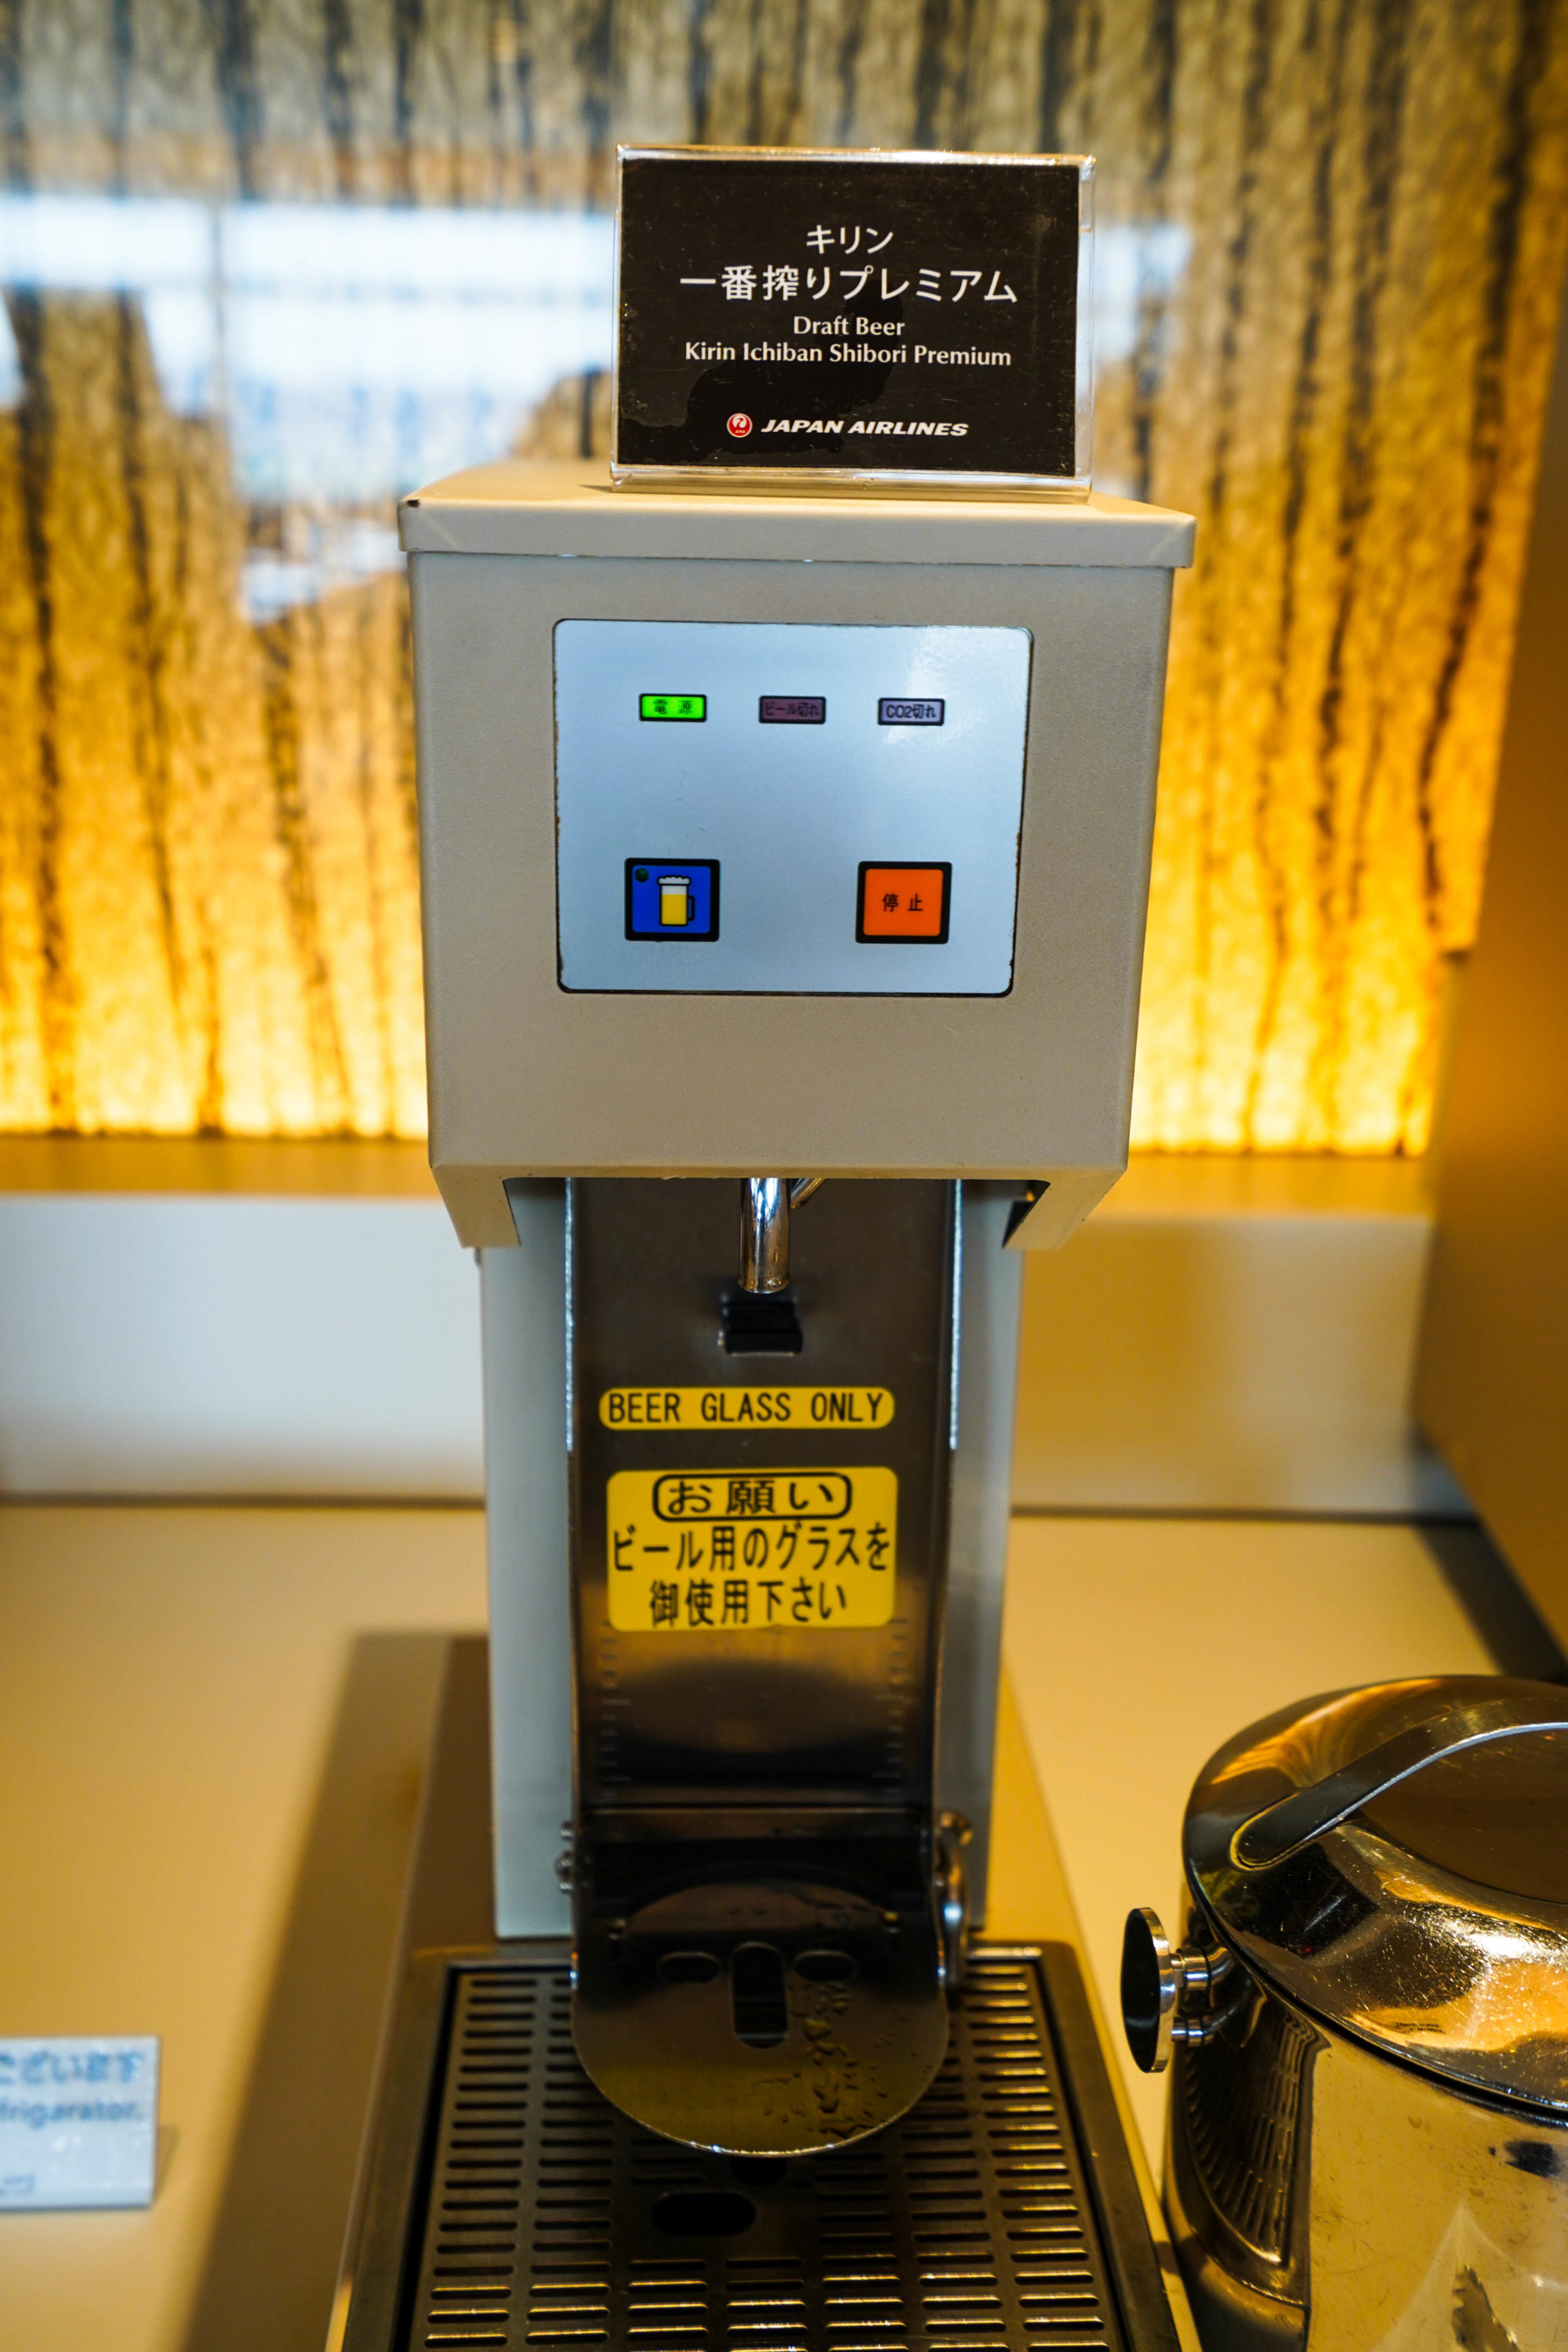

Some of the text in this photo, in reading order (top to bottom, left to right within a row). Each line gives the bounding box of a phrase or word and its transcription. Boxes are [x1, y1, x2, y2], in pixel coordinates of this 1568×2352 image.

[806, 224, 894, 255] キリン
[680, 264, 1018, 303] 一番搾りプレミアム
[793, 315, 906, 336] Draft Beer
[685, 342, 1011, 366] Kirin Ichiban Shibori Premium
[760, 419, 844, 434] JAPAN
[847, 420, 969, 437] AIRLINES
[882, 893, 924, 913] 停止
[608, 1392, 884, 1423] BEER GLASS ONLY
[668, 1479, 833, 1515] お願い
[613, 1520, 891, 1572] ビール用のグラスを
[649, 1577, 847, 1628] 御使用下さい
